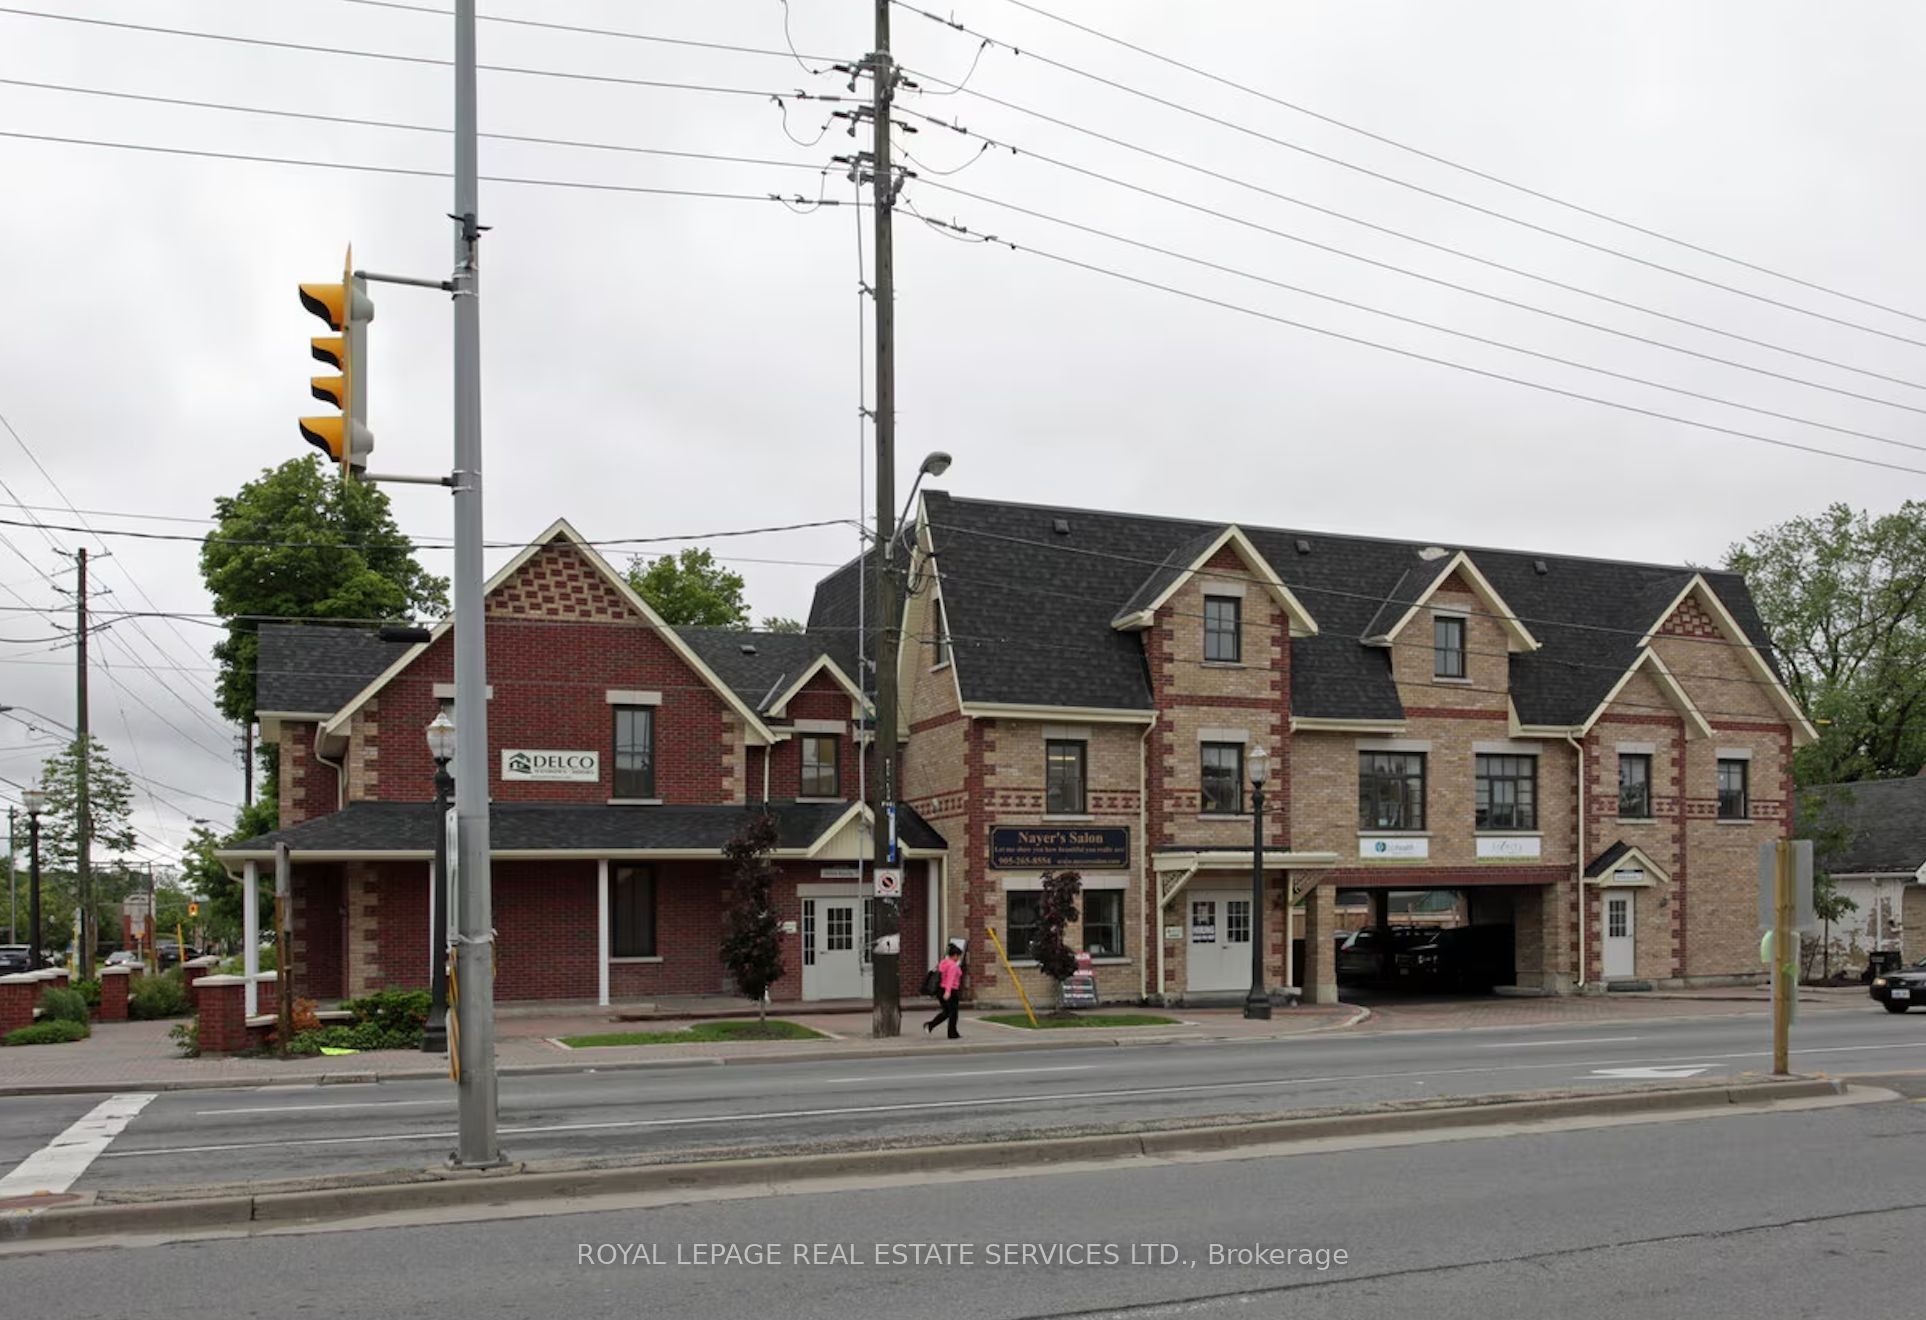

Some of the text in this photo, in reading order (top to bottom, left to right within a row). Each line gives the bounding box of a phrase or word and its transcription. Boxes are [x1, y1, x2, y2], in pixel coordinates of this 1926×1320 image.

[533, 756, 594, 769] DELCO
[1018, 831, 1104, 846] Nayer's Salon
